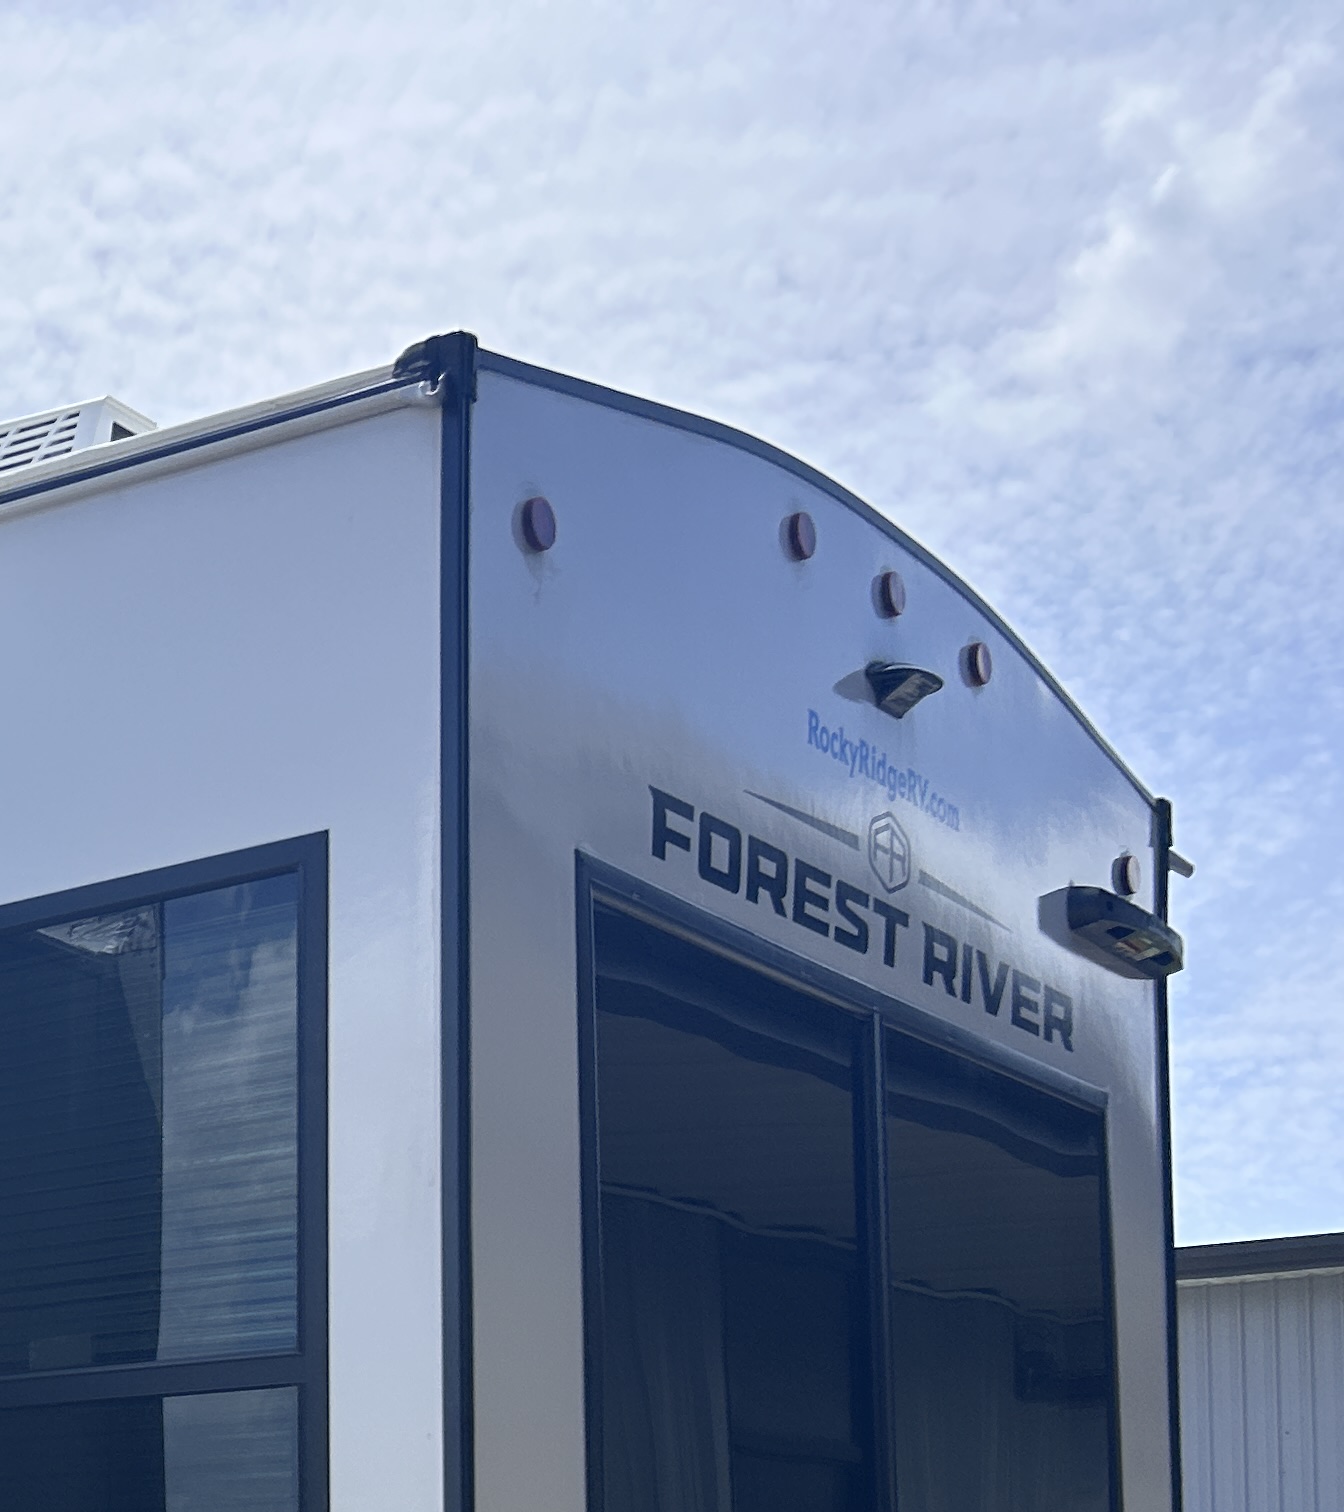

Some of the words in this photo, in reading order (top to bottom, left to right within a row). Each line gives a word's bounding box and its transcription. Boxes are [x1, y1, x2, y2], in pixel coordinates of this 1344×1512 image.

[807, 708, 960, 831] RockyRidgeRV.com
[648, 784, 909, 967] FOREST
[921, 920, 1074, 1052] RIVER
